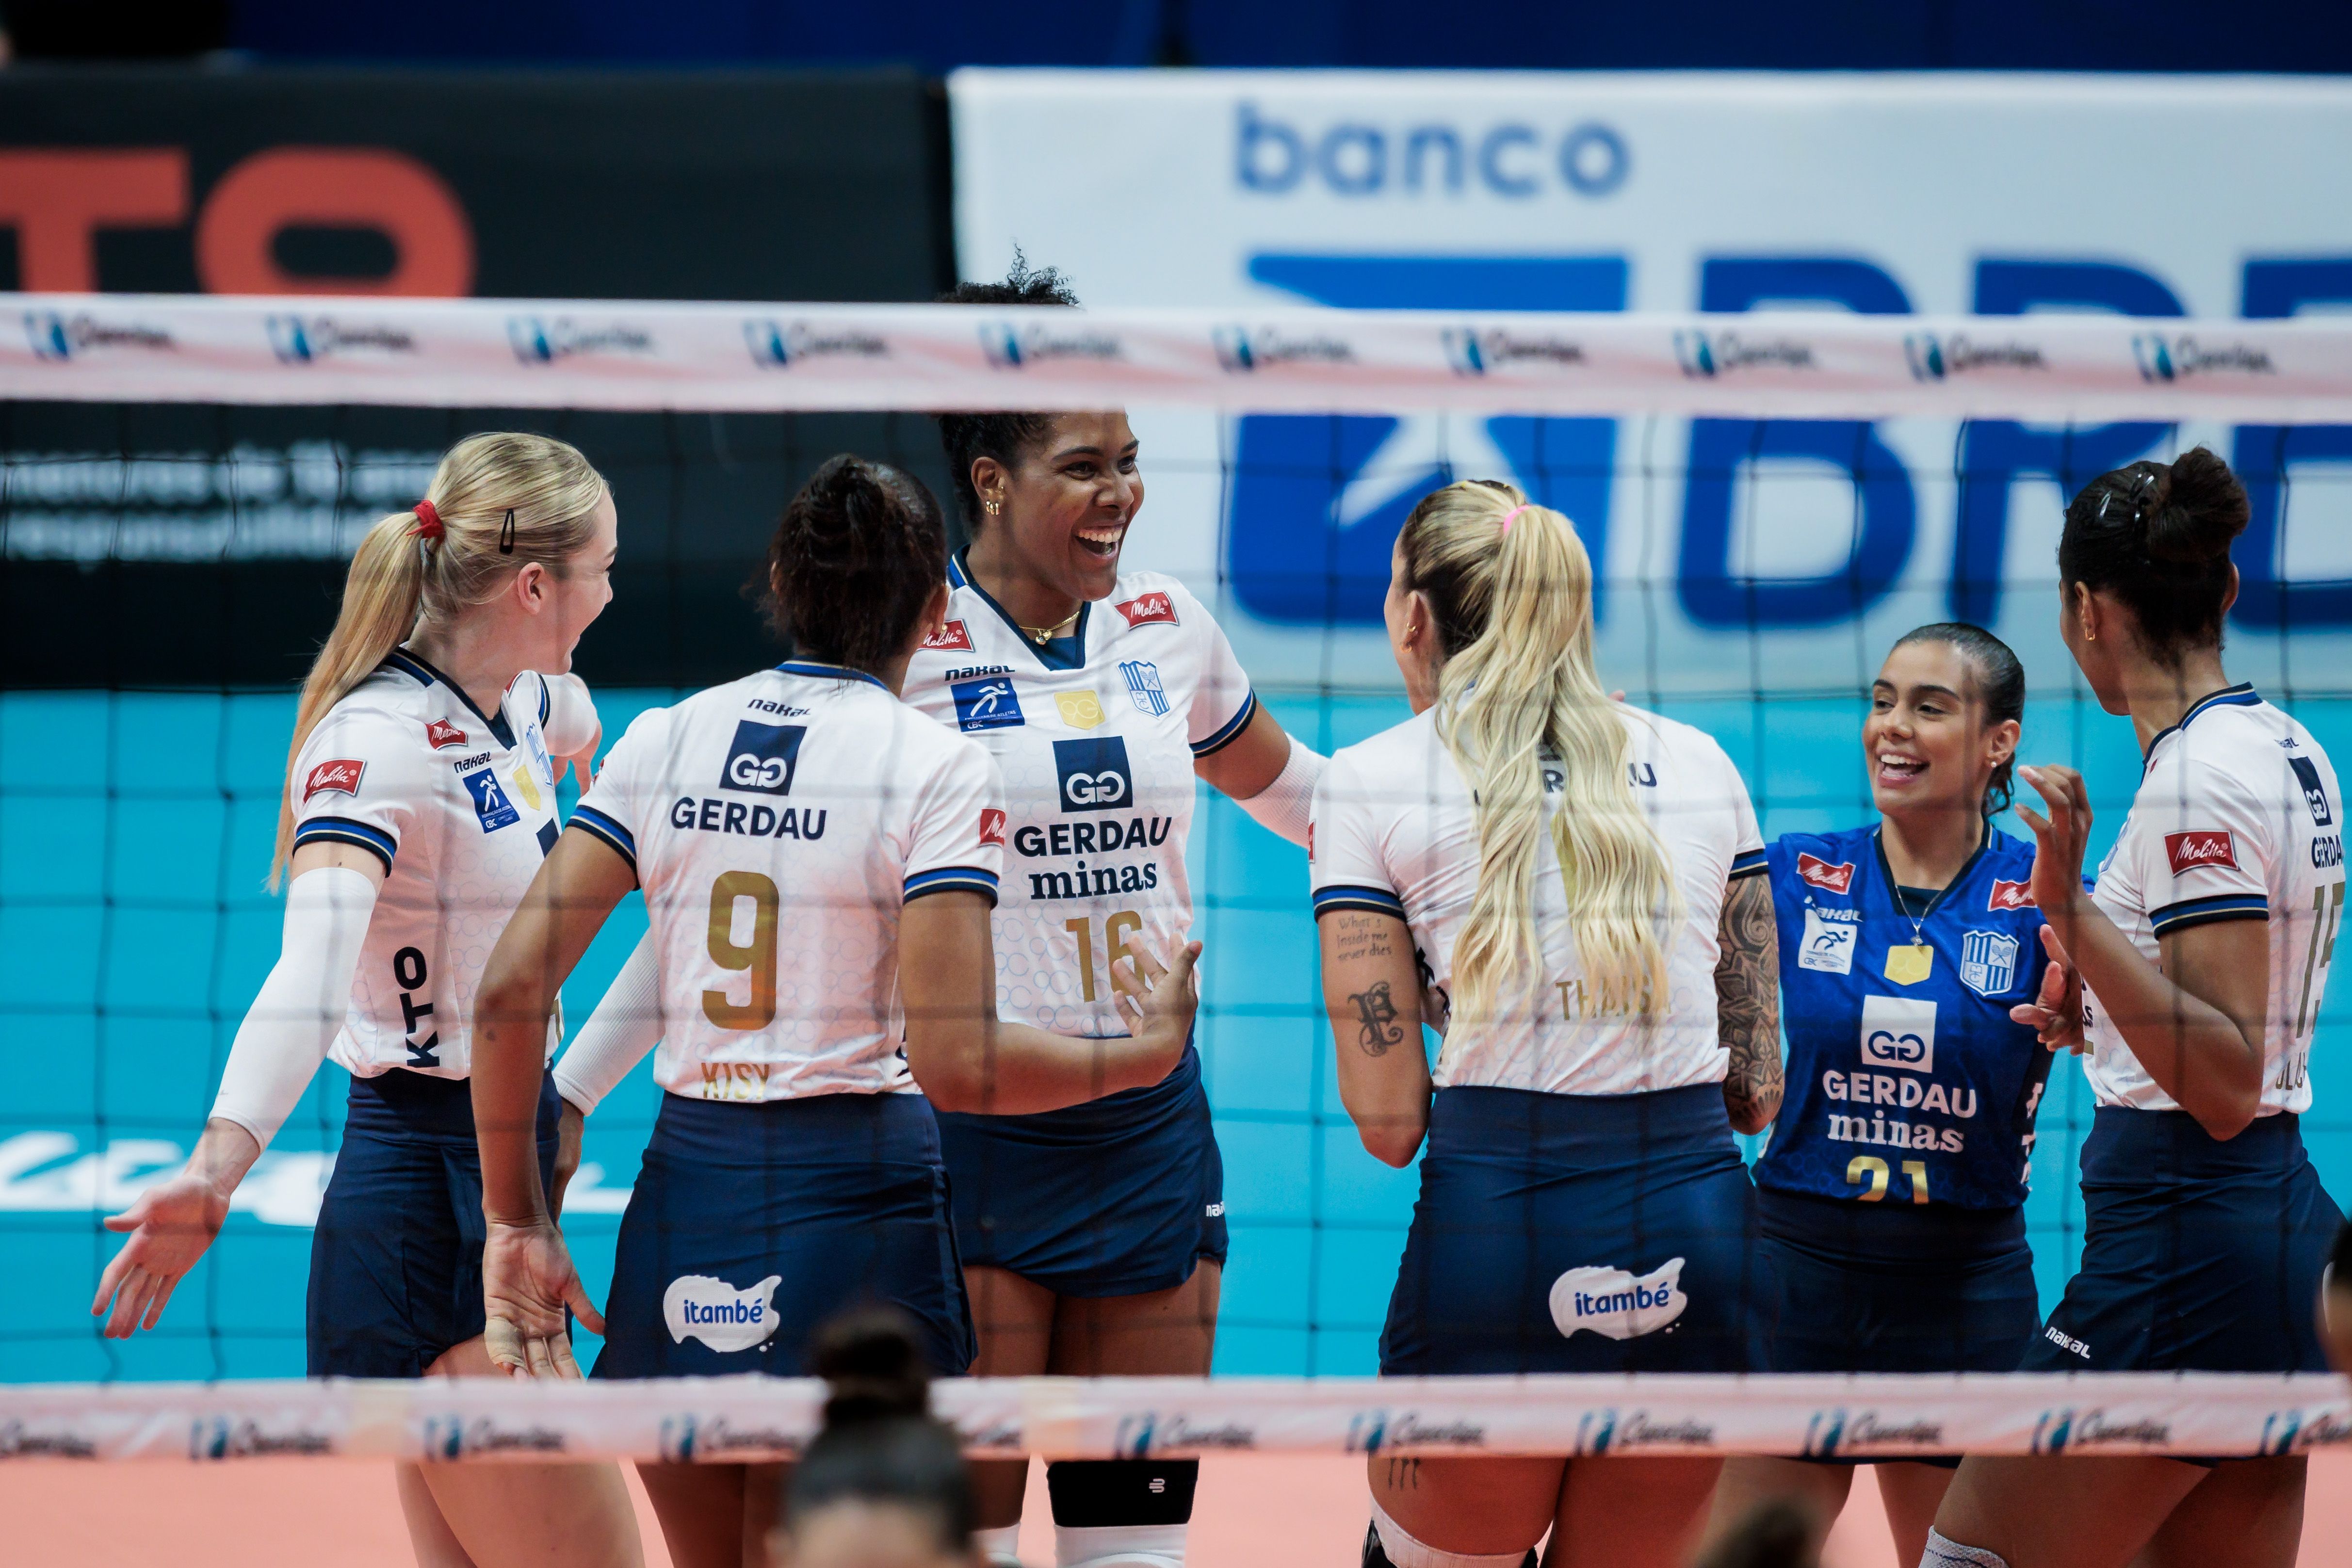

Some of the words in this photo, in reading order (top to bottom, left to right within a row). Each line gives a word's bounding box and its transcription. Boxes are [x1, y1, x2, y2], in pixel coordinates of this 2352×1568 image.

[1237, 101, 1630, 196] banco
[1131, 598, 1167, 617] Melitta
[310, 765, 349, 788] Melitta
[671, 797, 827, 841] GERDAU
[1014, 817, 1172, 857] GERDAU
[2175, 836, 2226, 863] Melitta
[1028, 860, 1158, 900] minas
[702, 870, 779, 1031] 9
[1066, 910, 1147, 1002] 16
[393, 946, 440, 1068] KTO
[1556, 975, 1671, 1021] THAIS
[701, 1062, 770, 1099] KISY
[1822, 1070, 1977, 1118] GERDAU
[1828, 1110, 1964, 1153] minas
[684, 1298, 763, 1324] itambé
[1575, 1281, 1669, 1317] itambé
